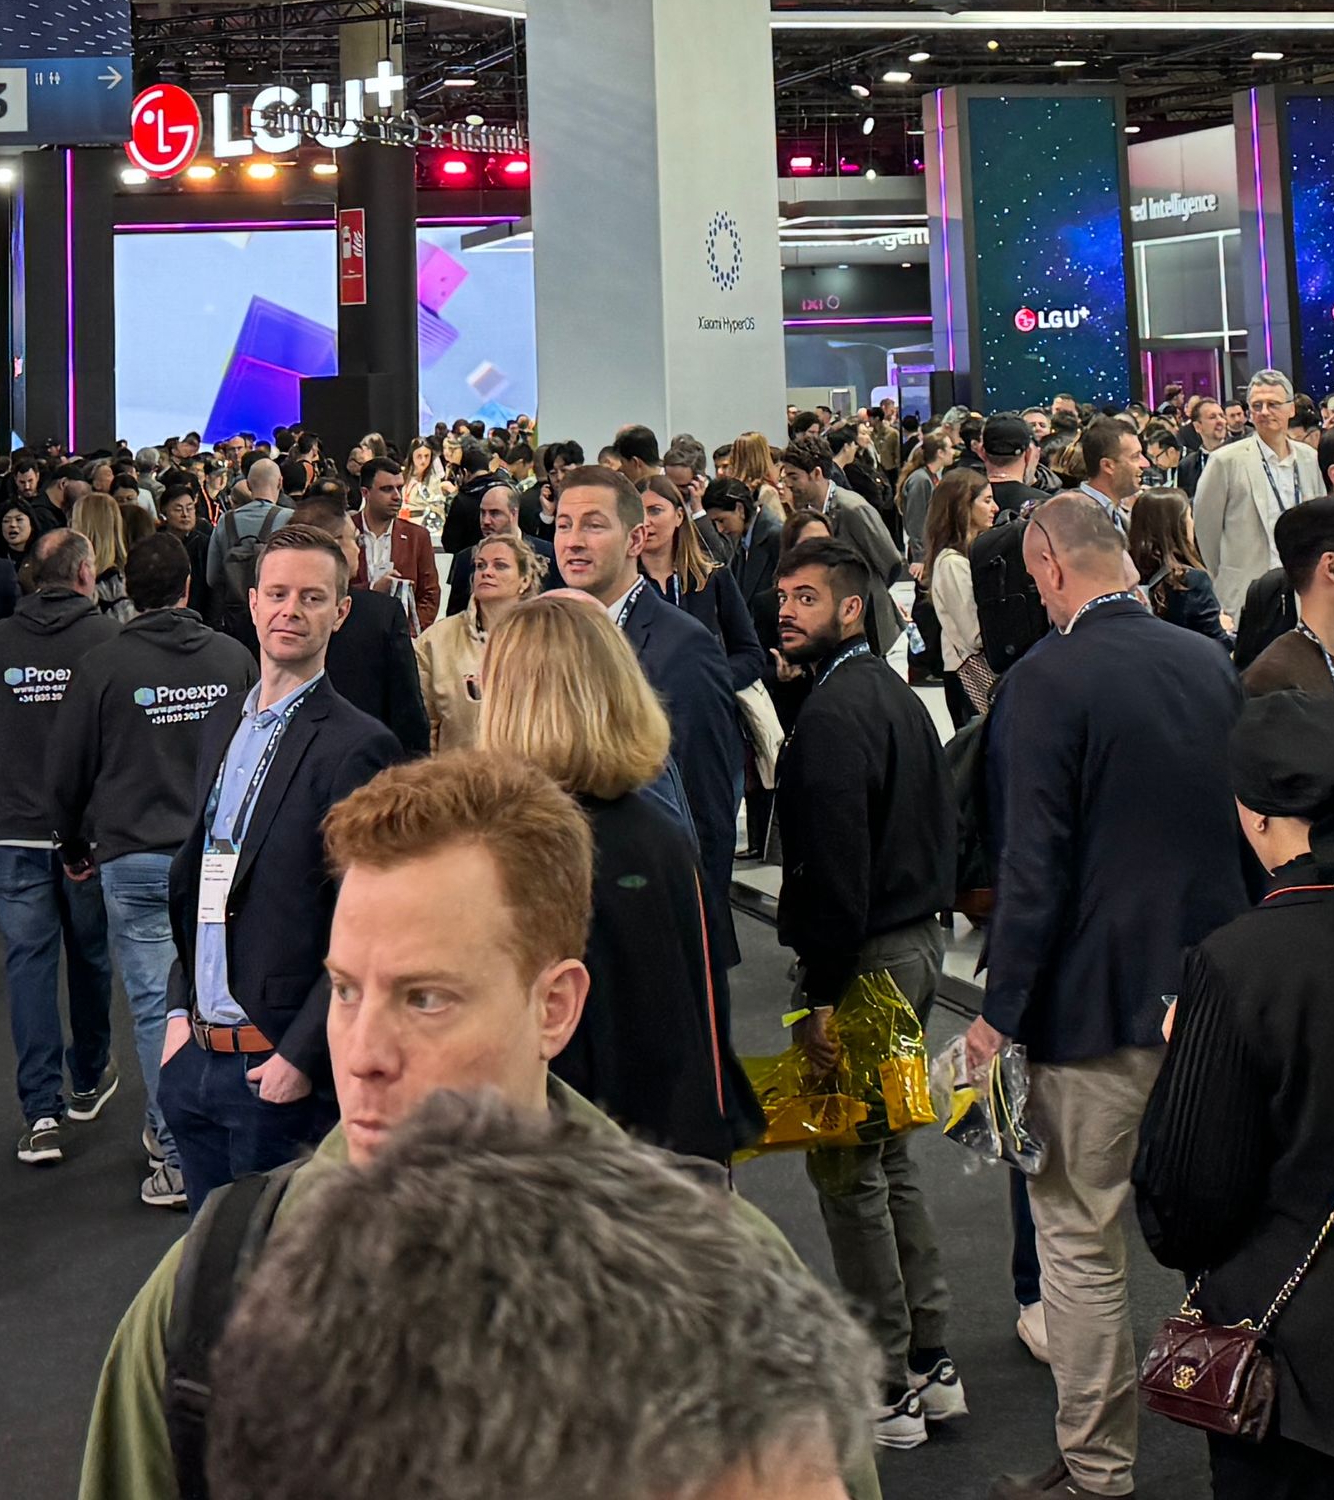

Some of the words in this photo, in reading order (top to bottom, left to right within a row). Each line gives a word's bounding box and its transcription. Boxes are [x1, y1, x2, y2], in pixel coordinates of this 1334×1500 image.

[1148, 192, 1217, 221] Intelligence
[1037, 306, 1091, 329] LGU+
[156, 683, 228, 704] Proexpo
